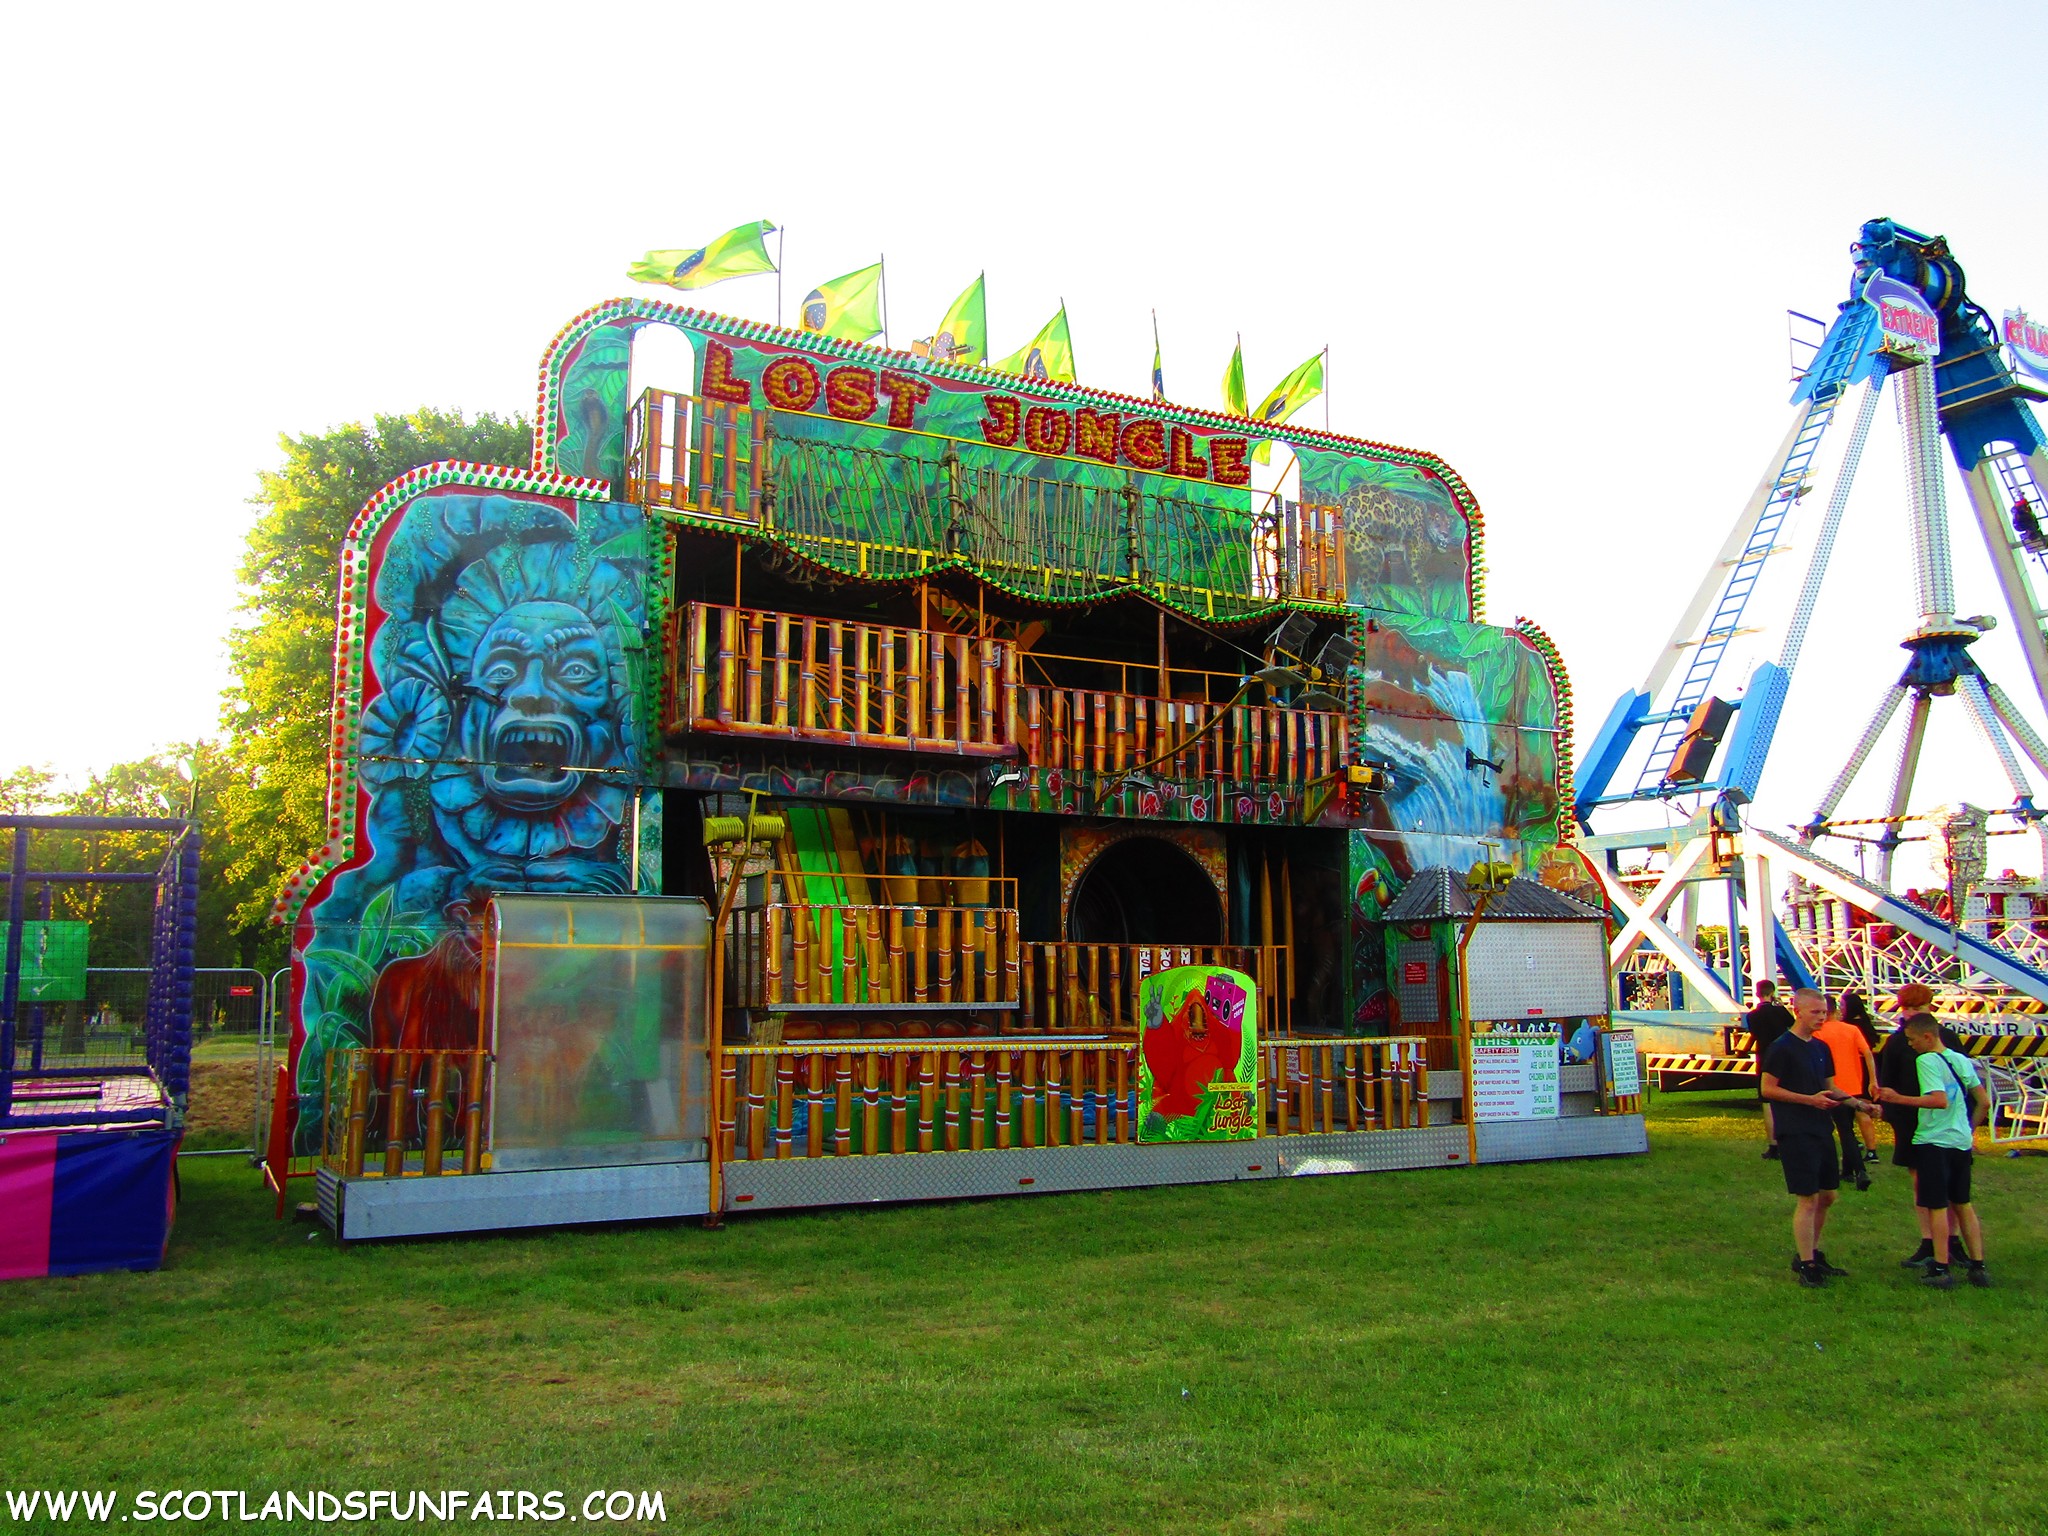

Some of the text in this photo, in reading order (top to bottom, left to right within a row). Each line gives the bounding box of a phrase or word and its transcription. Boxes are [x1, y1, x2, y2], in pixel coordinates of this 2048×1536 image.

[1880, 301, 1938, 345] EXTREME
[701, 338, 1250, 485] LOST JUNGLE
[1214, 1093, 1246, 1110] Lost
[1209, 1107, 1254, 1135] Jungle
